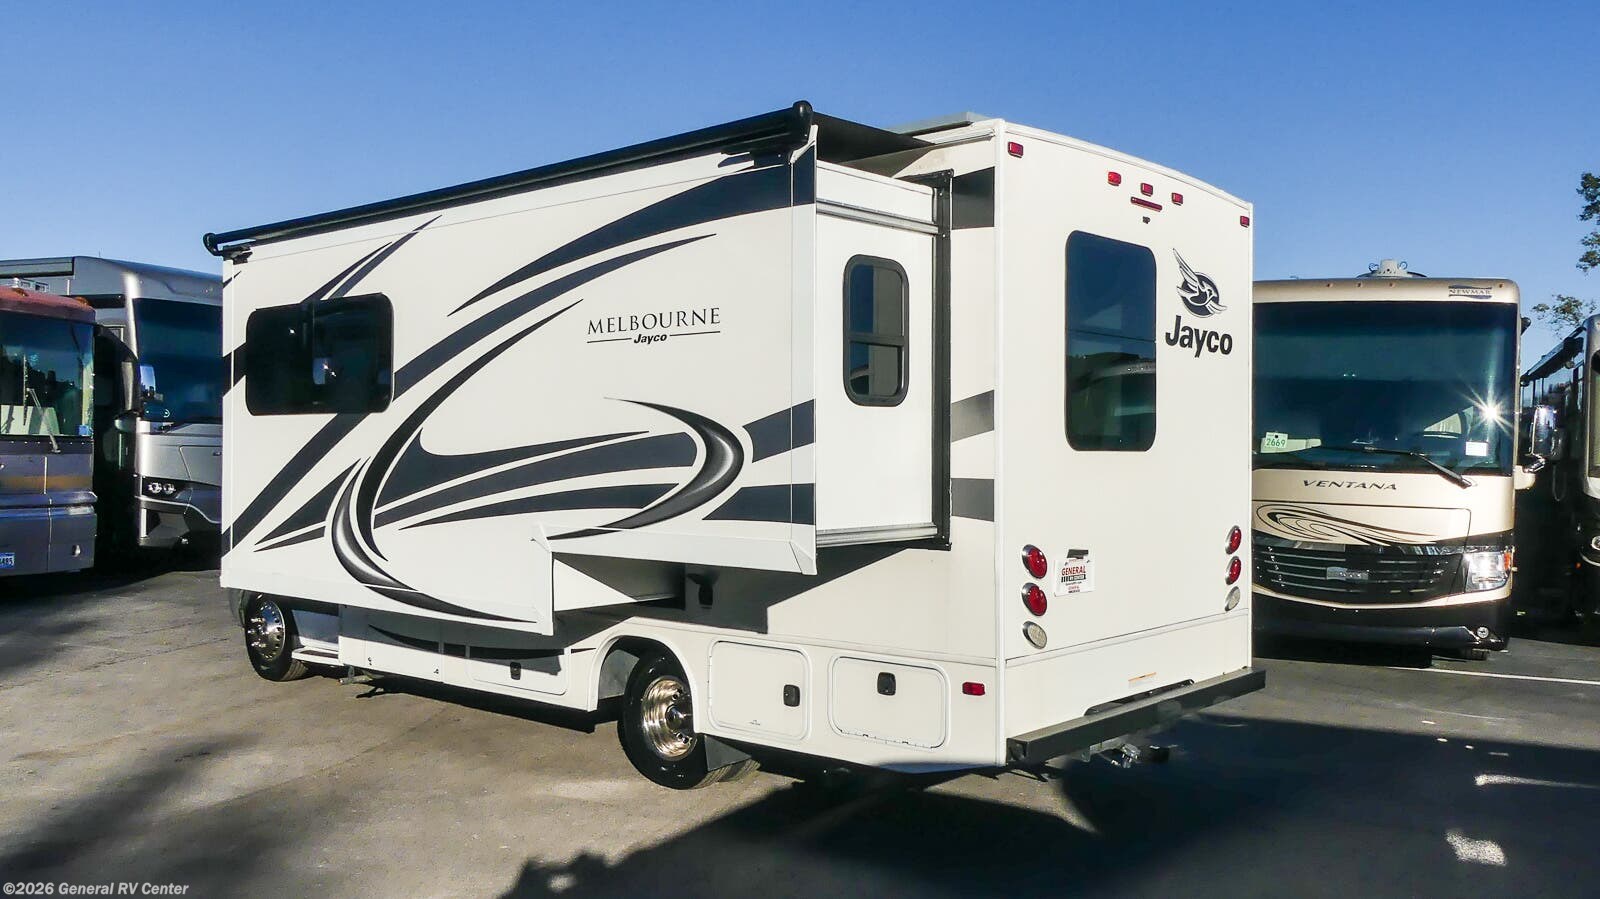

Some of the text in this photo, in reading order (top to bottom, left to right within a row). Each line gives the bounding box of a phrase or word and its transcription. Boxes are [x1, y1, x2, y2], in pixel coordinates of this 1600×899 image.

[587, 307, 721, 335] MELBOURNE
[633, 333, 668, 345] Jayco
[1165, 315, 1233, 358] Jayco
[1266, 438, 1286, 447] 2669
[1303, 479, 1397, 490] VENTANA
[1061, 565, 1087, 576] GENERAL
